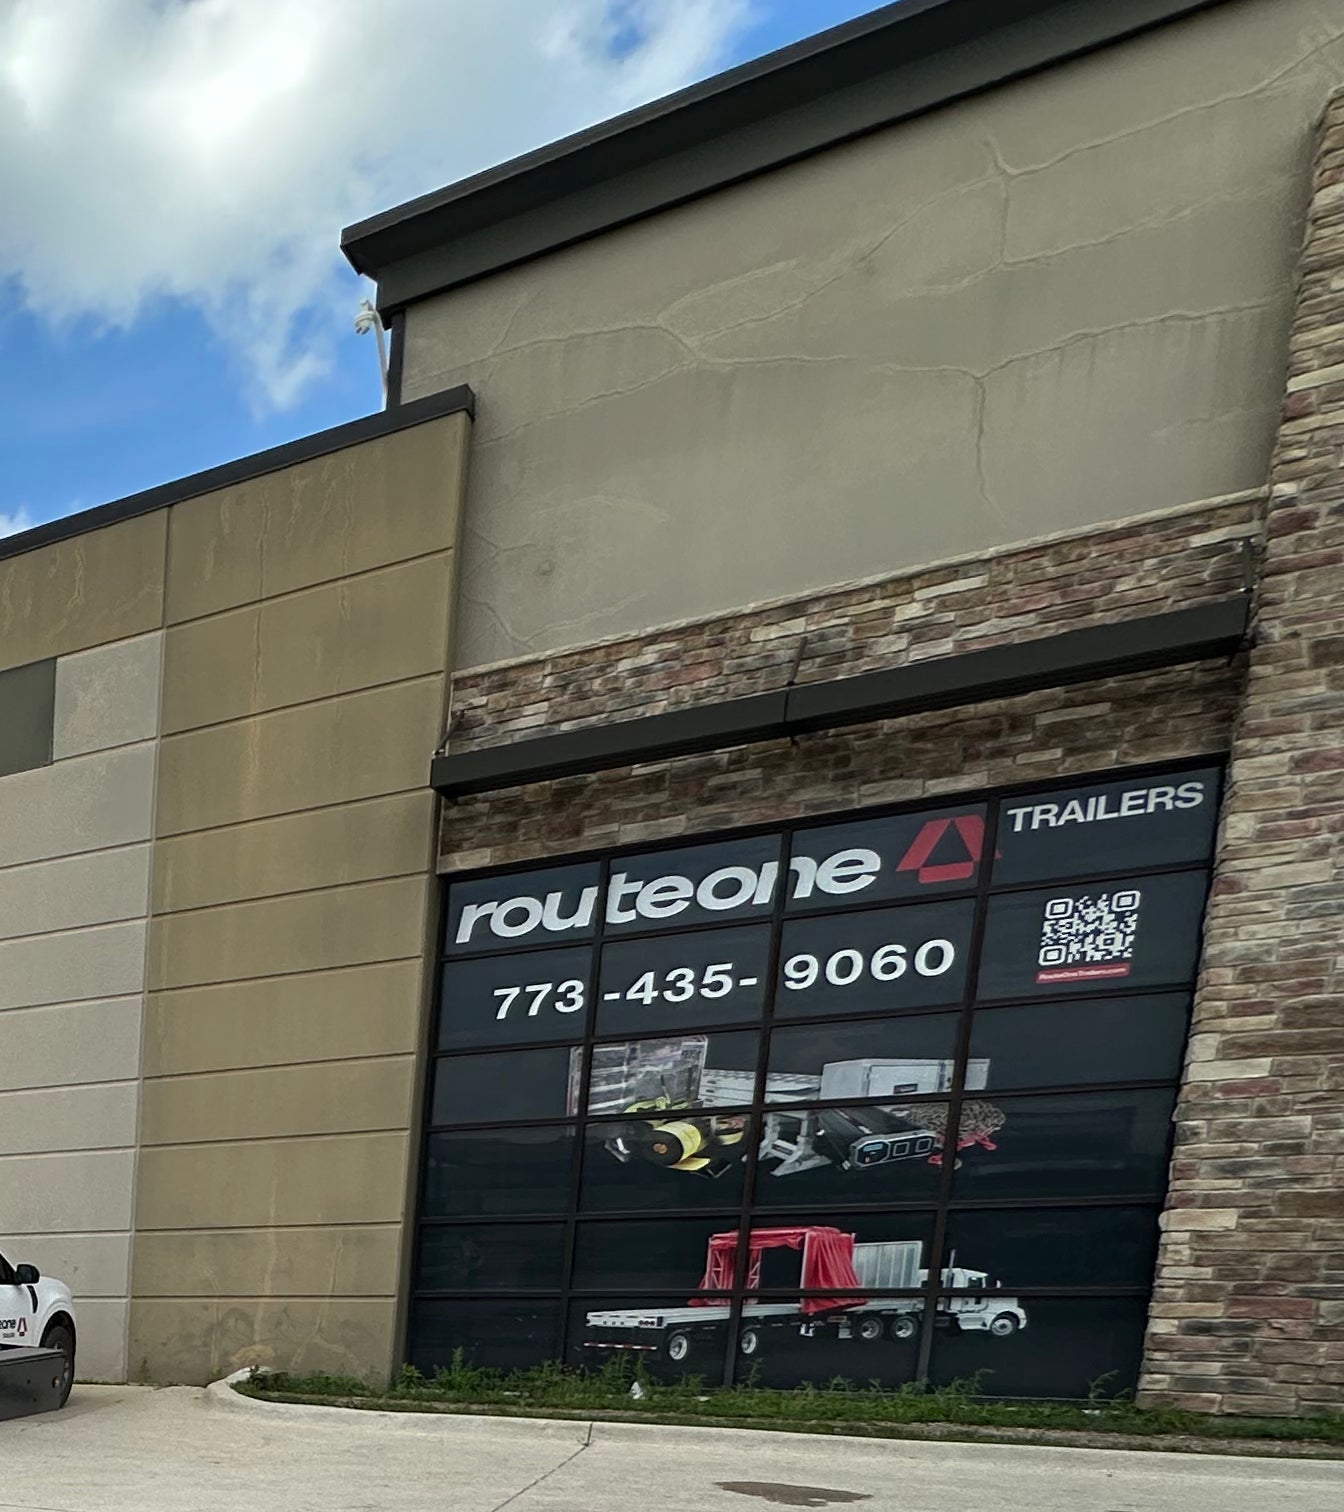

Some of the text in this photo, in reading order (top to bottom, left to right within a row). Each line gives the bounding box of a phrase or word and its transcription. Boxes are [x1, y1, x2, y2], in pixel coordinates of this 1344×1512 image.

[1007, 781, 1204, 833] TRAILERS
[455, 848, 882, 944] routeone
[493, 979, 584, 1020] 773
[783, 938, 956, 991] 9060
